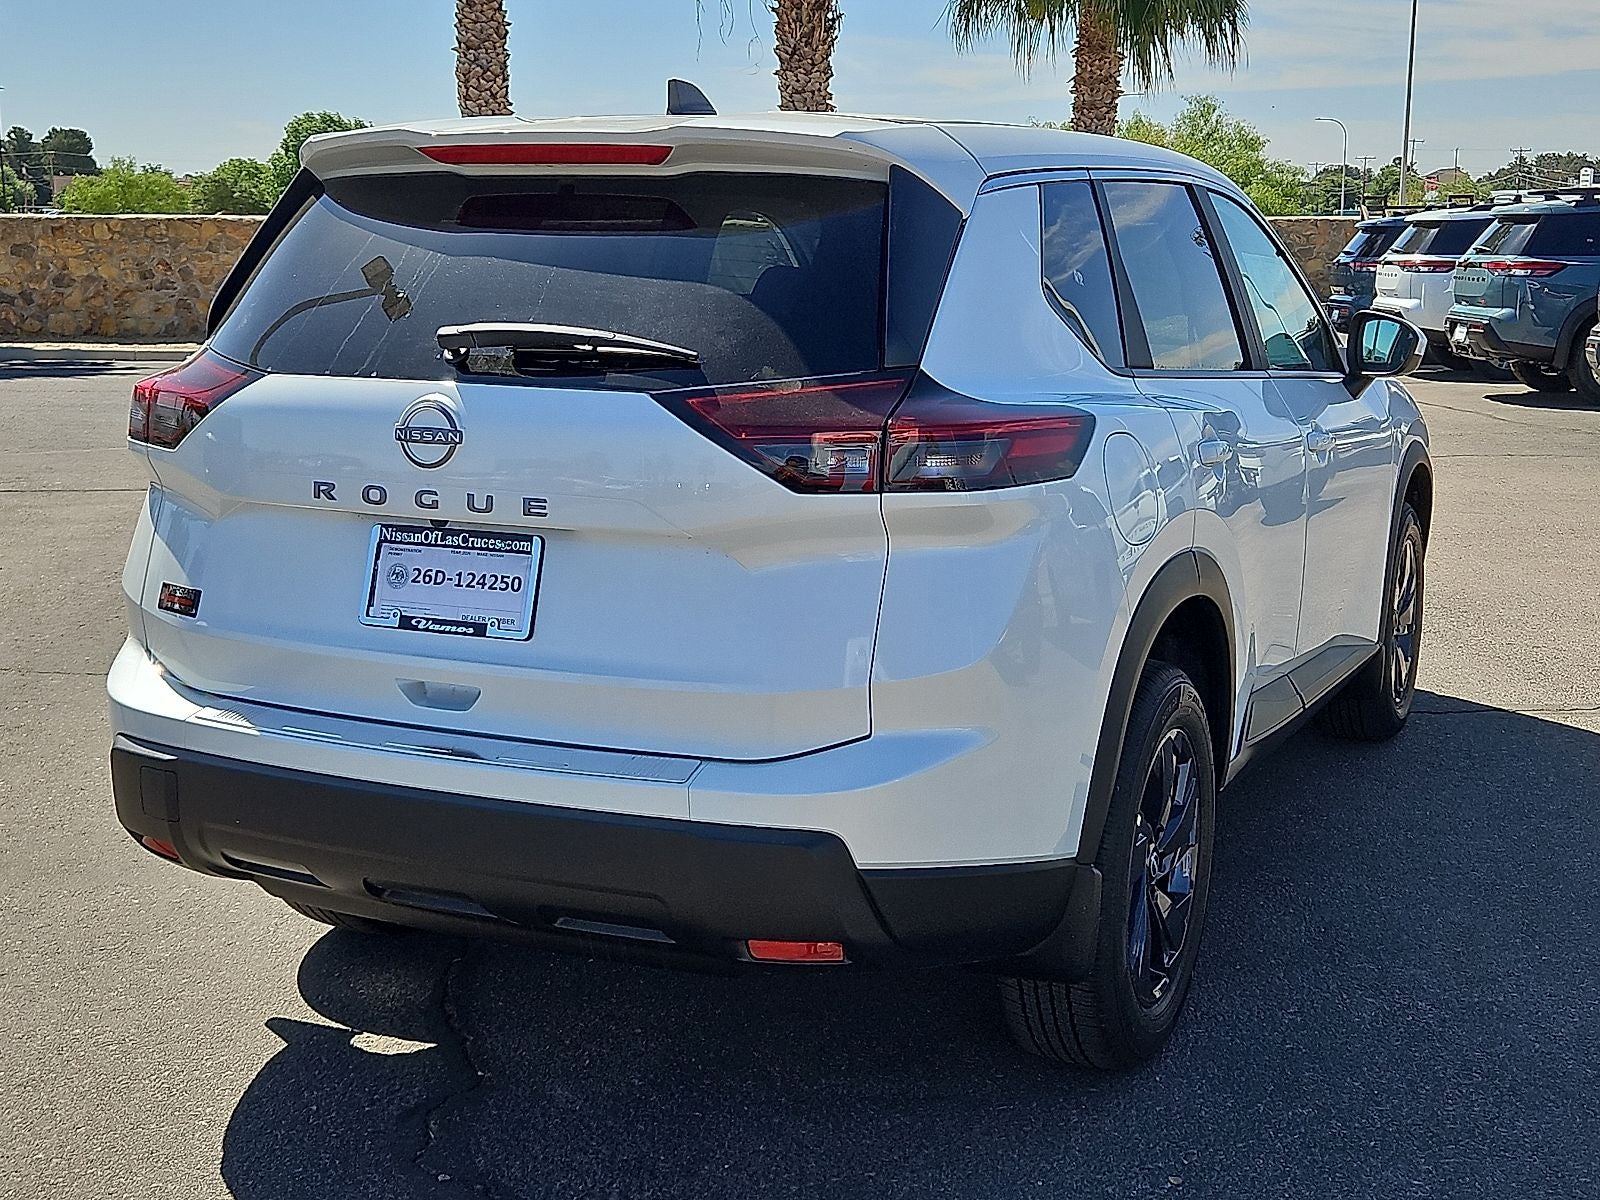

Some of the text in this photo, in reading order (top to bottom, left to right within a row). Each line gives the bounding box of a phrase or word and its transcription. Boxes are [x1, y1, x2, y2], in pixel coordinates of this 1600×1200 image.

[395, 428, 461, 443] NISSAN
[313, 481, 549, 517] ROGUE
[380, 527, 532, 552] NissanOfLasCruces.com
[410, 567, 523, 593] 26D-124250
[411, 618, 475, 635] Vamos
[461, 614, 487, 623] DEALER
